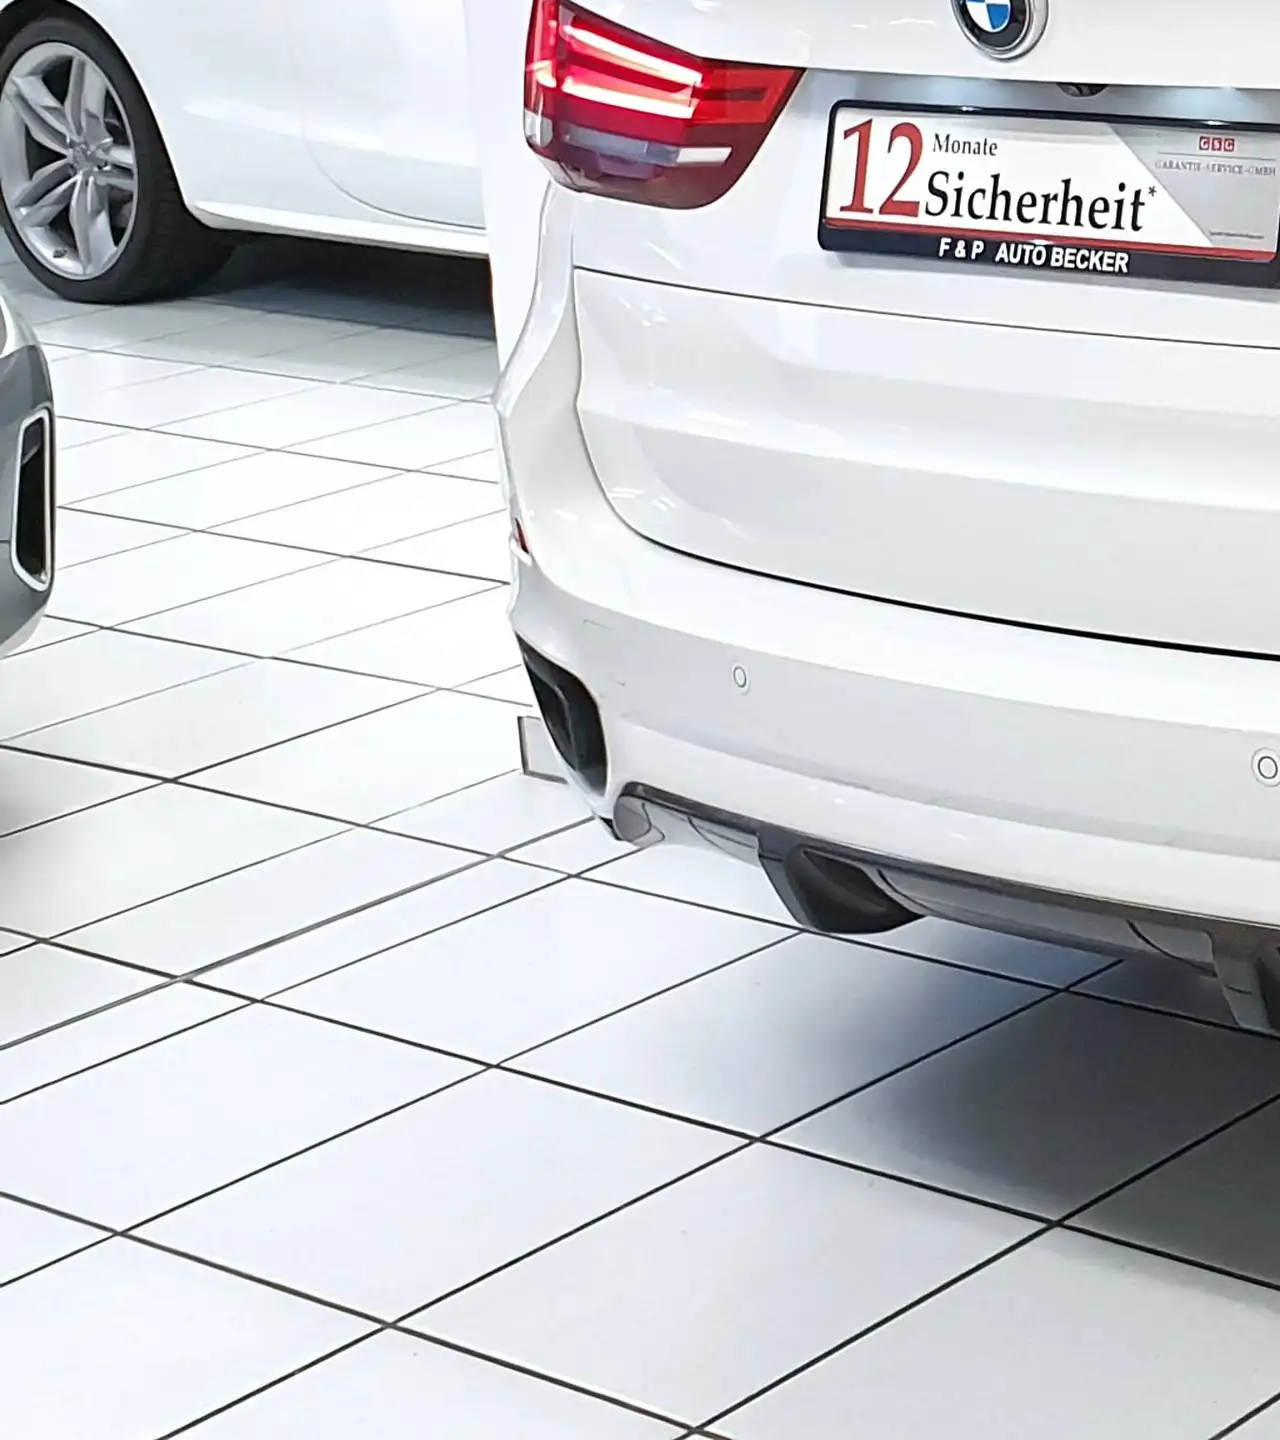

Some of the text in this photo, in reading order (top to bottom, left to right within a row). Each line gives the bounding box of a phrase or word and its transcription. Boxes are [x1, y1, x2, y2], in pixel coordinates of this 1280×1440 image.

[1199, 136, 1236, 152] GSG
[839, 117, 998, 218] 12 Monate
[938, 238, 1130, 274] F & P AUTO BECKER
